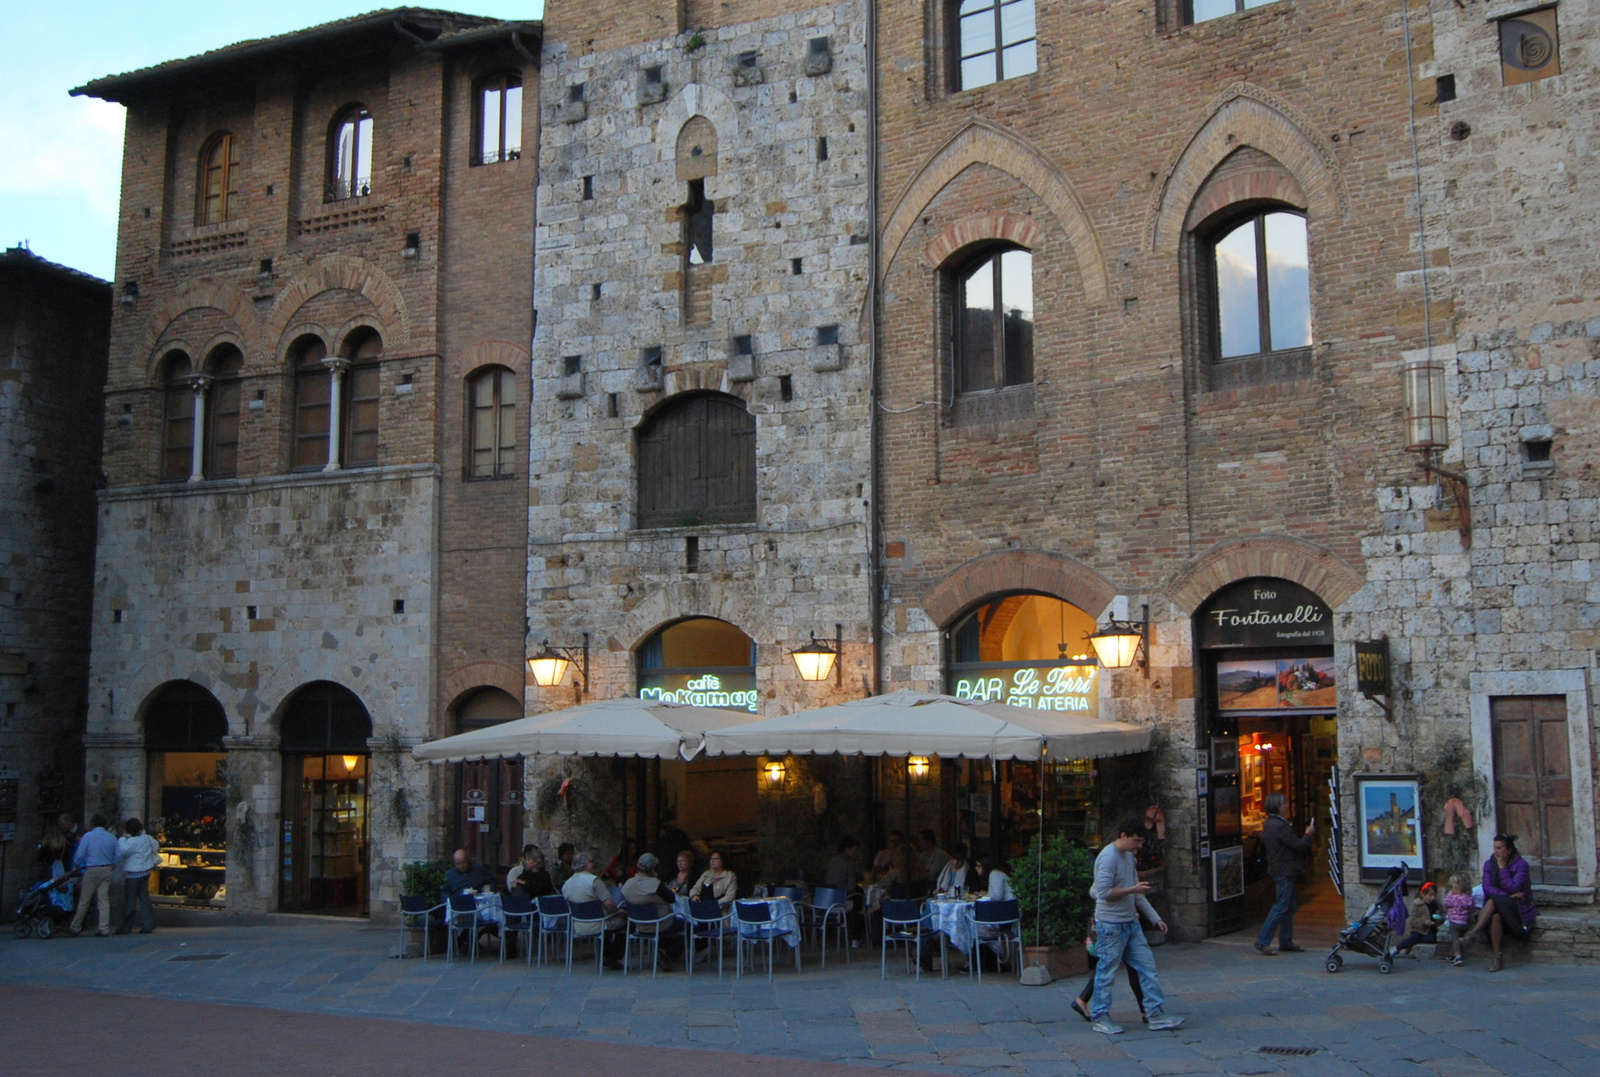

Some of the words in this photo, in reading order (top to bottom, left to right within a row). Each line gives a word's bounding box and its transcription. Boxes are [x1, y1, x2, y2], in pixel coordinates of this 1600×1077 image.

[1253, 589, 1277, 600] Foto
[1210, 604, 1324, 627] Fontanelli
[1357, 652, 1384, 681] FOTO
[687, 673, 720, 691] caffè
[955, 677, 1003, 702] BAR
[1009, 667, 1040, 696] Le
[1042, 667, 1096, 695] Torri
